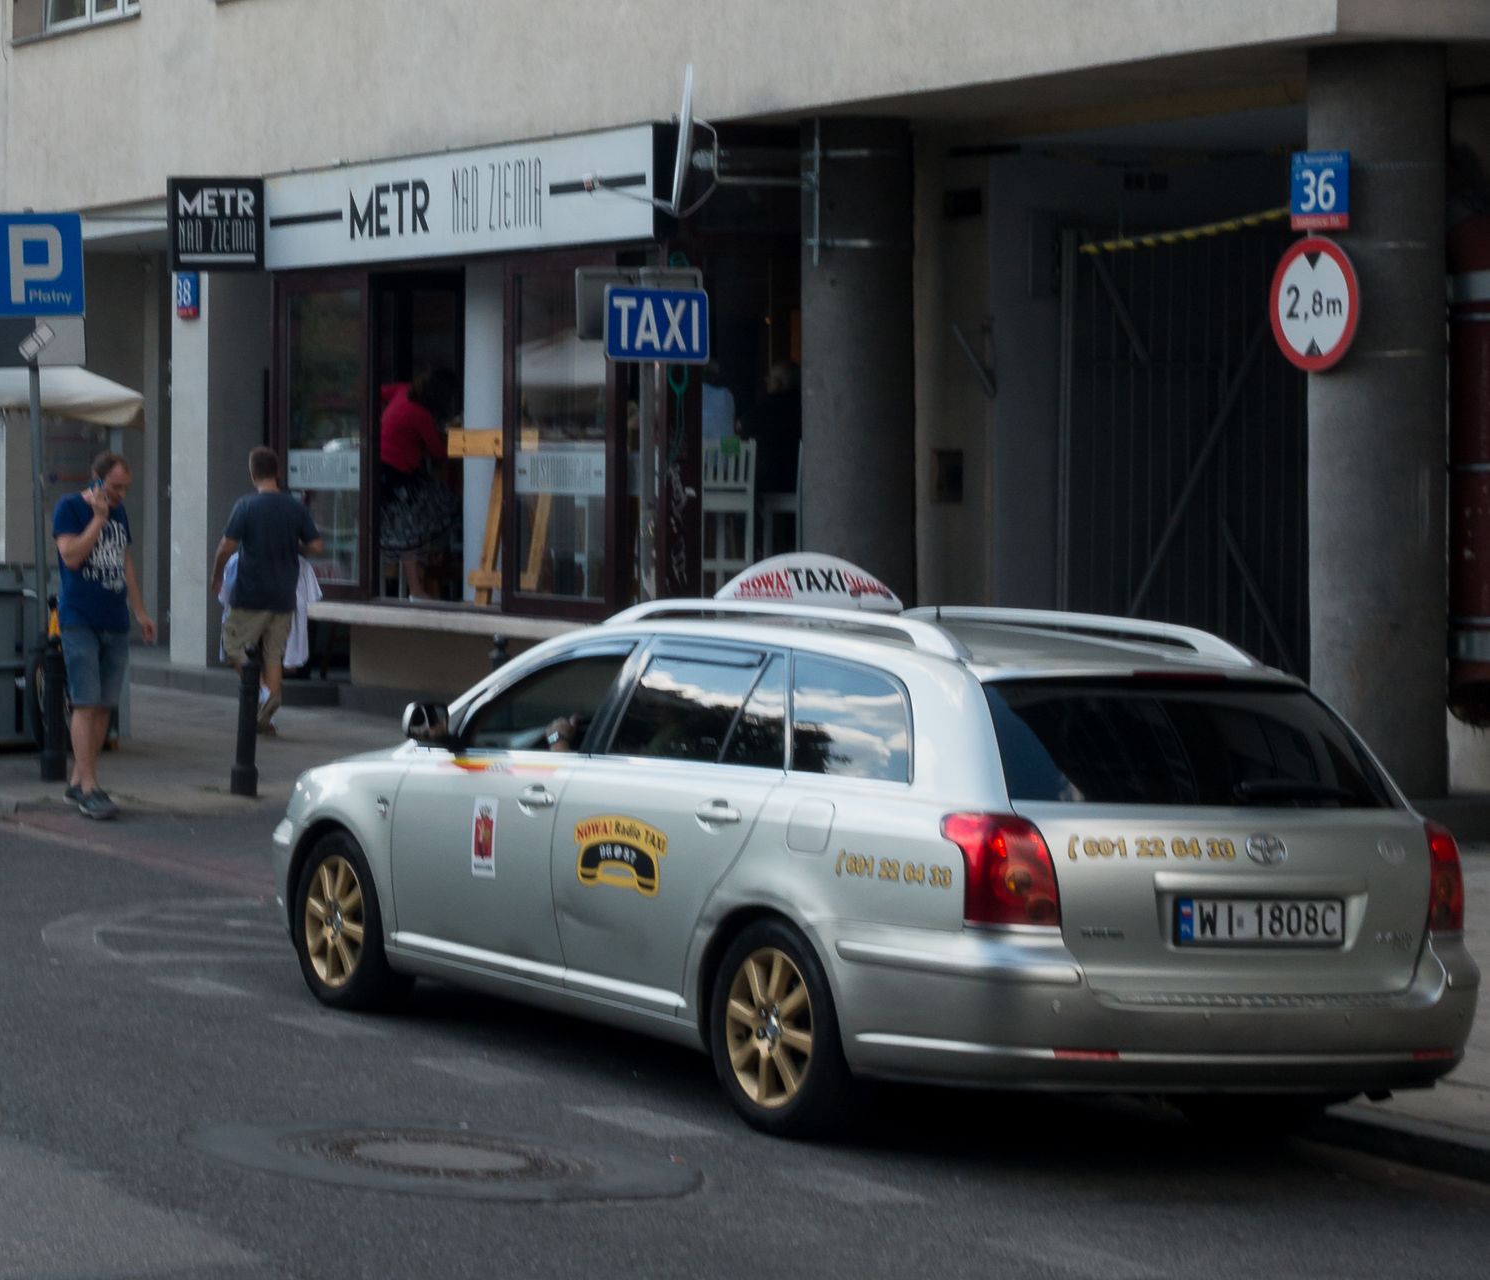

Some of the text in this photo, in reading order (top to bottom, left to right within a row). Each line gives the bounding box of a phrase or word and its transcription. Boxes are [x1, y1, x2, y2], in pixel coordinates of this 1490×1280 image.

[177, 187, 256, 218] METR
[348, 178, 430, 241] METR
[451, 164, 480, 235] NAD
[1300, 168, 1336, 213] 36
[178, 218, 204, 254] NAD
[8, 223, 64, 305] P
[613, 295, 700, 353] TAXI
[788, 566, 848, 593] TAXI
[1197, 901, 1235, 938] WI
[1253, 901, 1338, 938] 1808C
